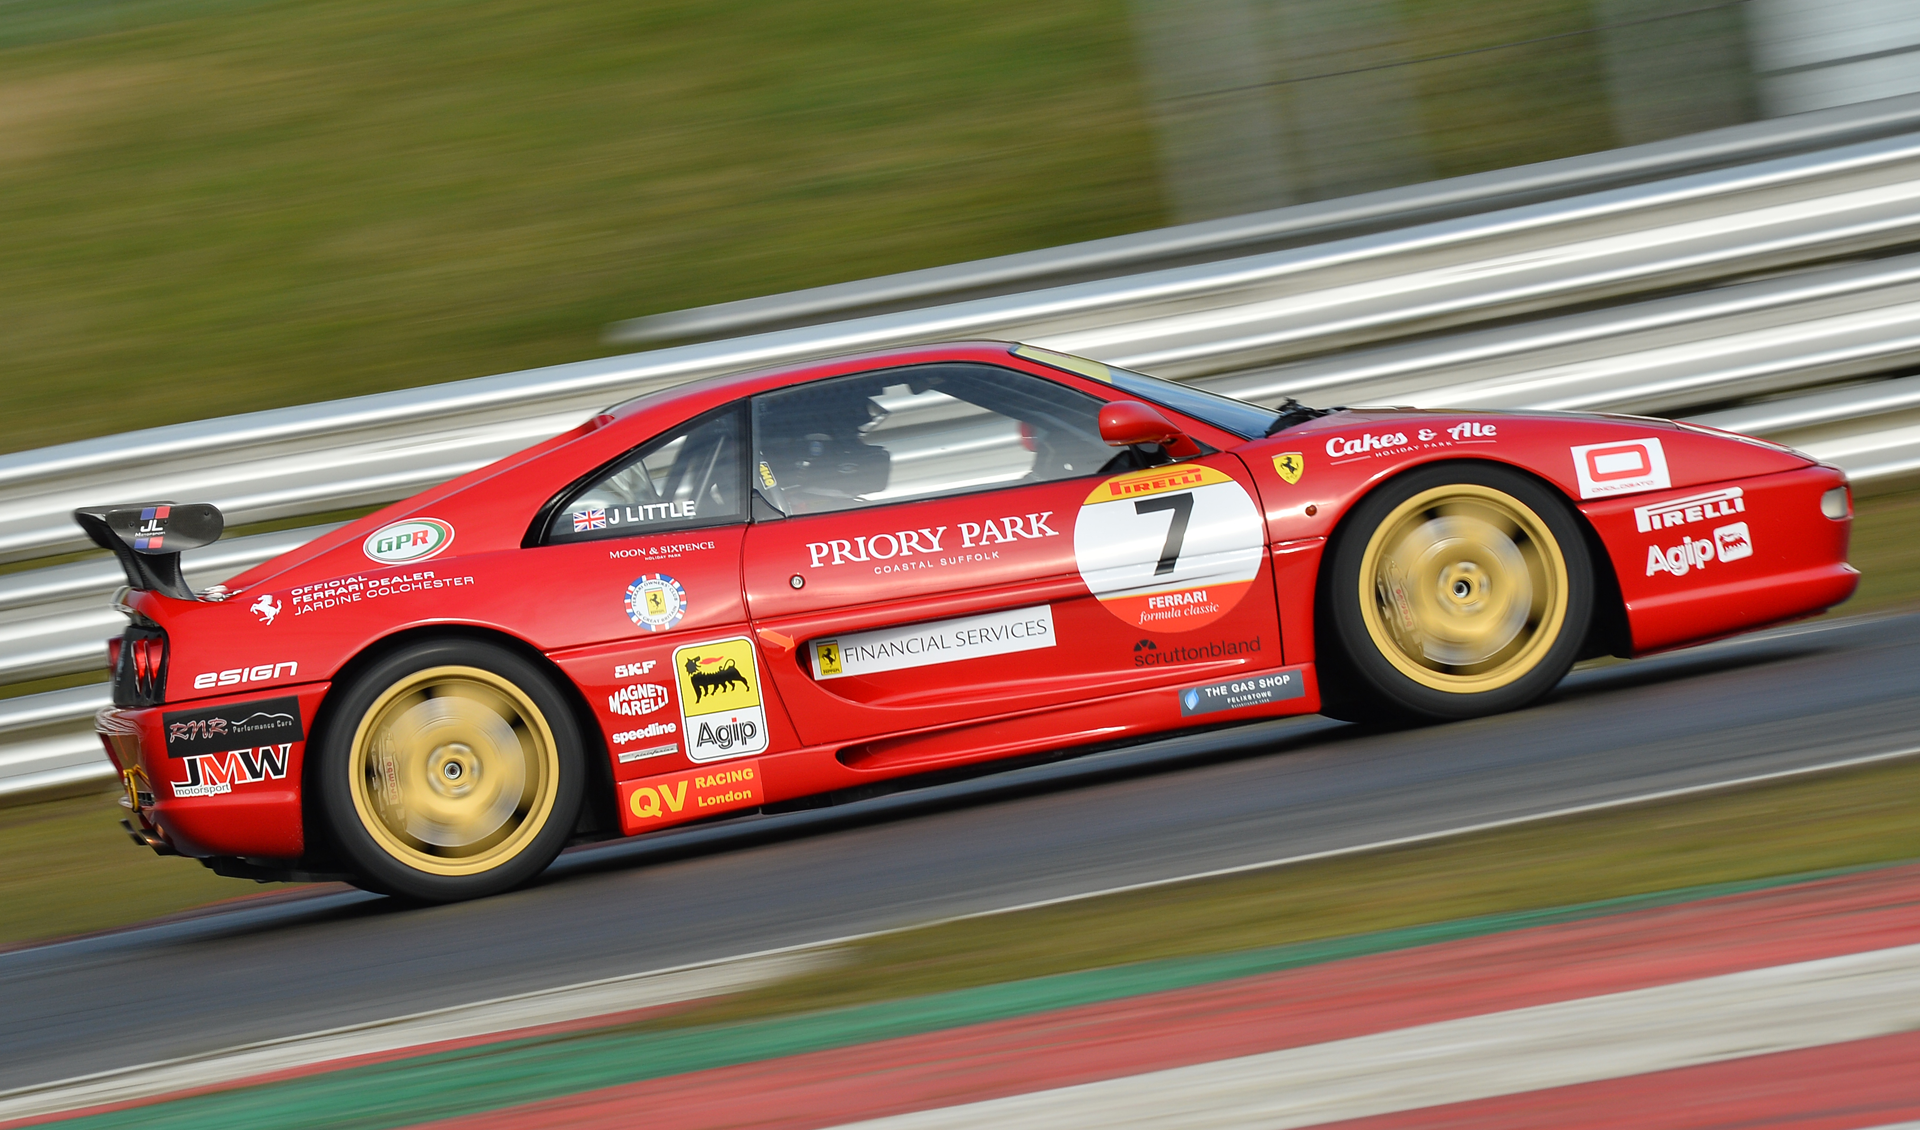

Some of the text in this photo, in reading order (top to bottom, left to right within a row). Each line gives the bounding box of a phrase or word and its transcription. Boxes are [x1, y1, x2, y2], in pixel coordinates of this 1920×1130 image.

[1325, 422, 1497, 457] Cakes & Ale
[1375, 441, 1452, 458] HOLIDAY PARK
[1108, 468, 1202, 496] PIRELLI
[608, 501, 696, 524] J LITTLE
[1634, 486, 1746, 533] PIRELLI
[140, 519, 164, 532] JL
[1134, 491, 1194, 576] 7
[376, 529, 429, 554] GPR
[610, 541, 716, 560] MOON & SIXPENCE
[806, 511, 1060, 568] PRIORY PARK
[874, 551, 1000, 575] COASTAL SUFFOLK
[1646, 536, 1715, 576] Agip
[291, 576, 368, 596] OFFICIAL
[292, 571, 435, 606] FERRARI DEALER
[294, 576, 475, 616] JARDINE COLCHESTER
[1148, 590, 1208, 610] FERRARI
[1138, 602, 1220, 625] formula classic
[844, 618, 1048, 664] FINANCIAL SERVICES
[1134, 635, 1261, 667] scruttonbland
[614, 660, 656, 678] SKF
[608, 684, 668, 708] MAGNETI
[1205, 674, 1290, 698] THE GAS SHOP
[1226, 691, 1272, 704] FELIXSTOWE
[608, 691, 668, 716] MARELLI
[232, 722, 274, 734] Performance
[276, 720, 292, 728] Cars
[612, 722, 676, 744] speedline
[696, 717, 757, 750] Agip
[171, 744, 290, 788] JMW
[695, 768, 754, 788] RACING
[175, 782, 230, 796] motorsport
[629, 780, 688, 818] QV
[698, 789, 752, 807] London
